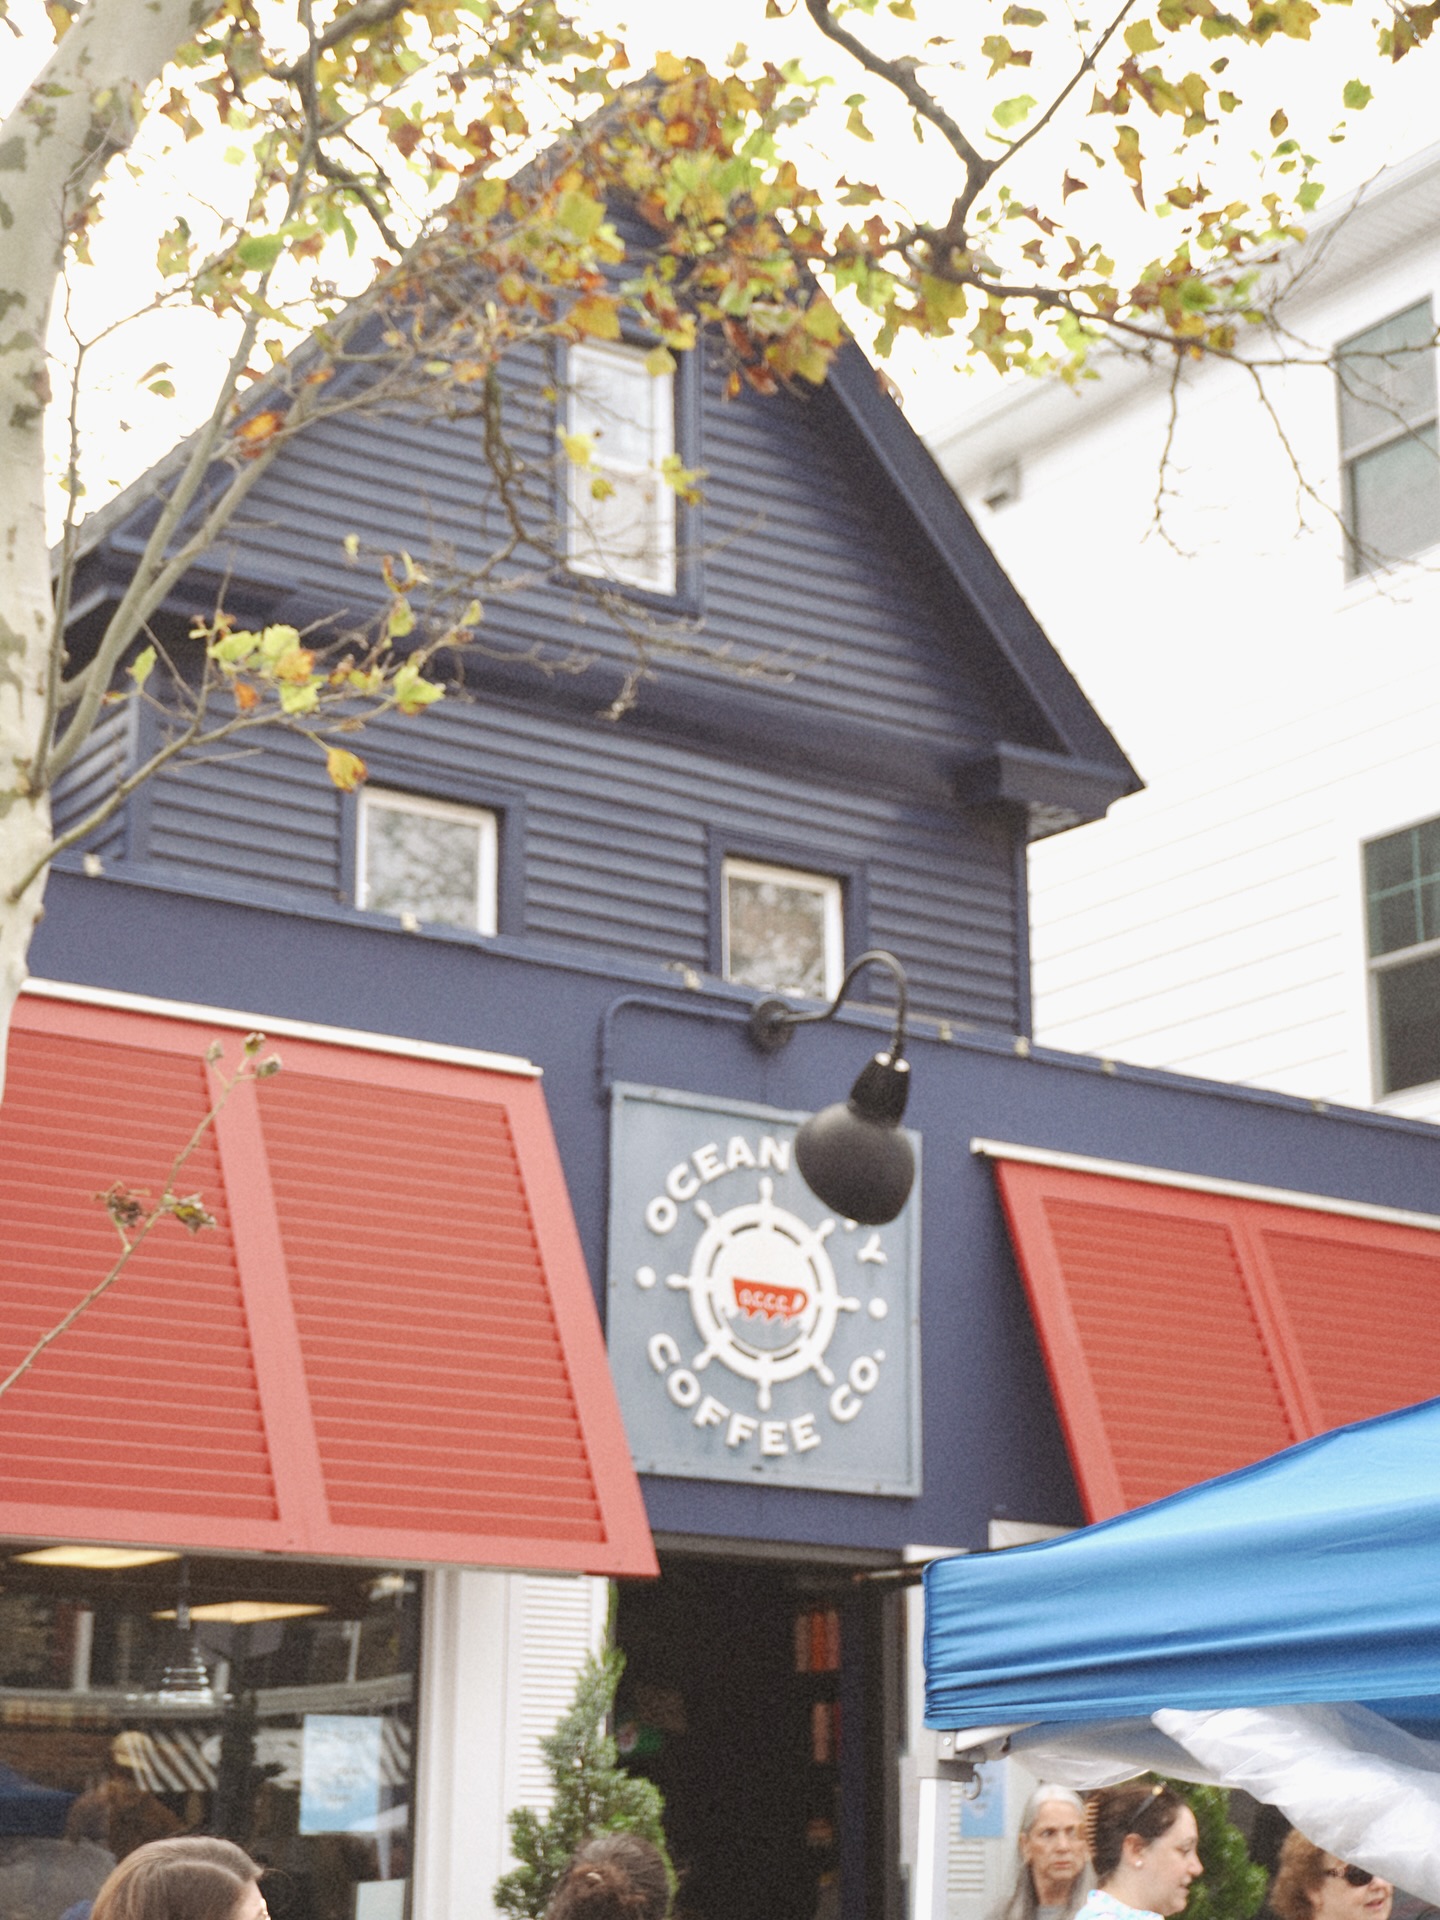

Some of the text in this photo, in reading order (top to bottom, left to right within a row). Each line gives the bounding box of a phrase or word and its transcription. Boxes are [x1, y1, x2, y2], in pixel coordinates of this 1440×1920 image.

[646, 1135, 791, 1234] OCEAN
[648, 1333, 886, 1455] COFFEE CO.
